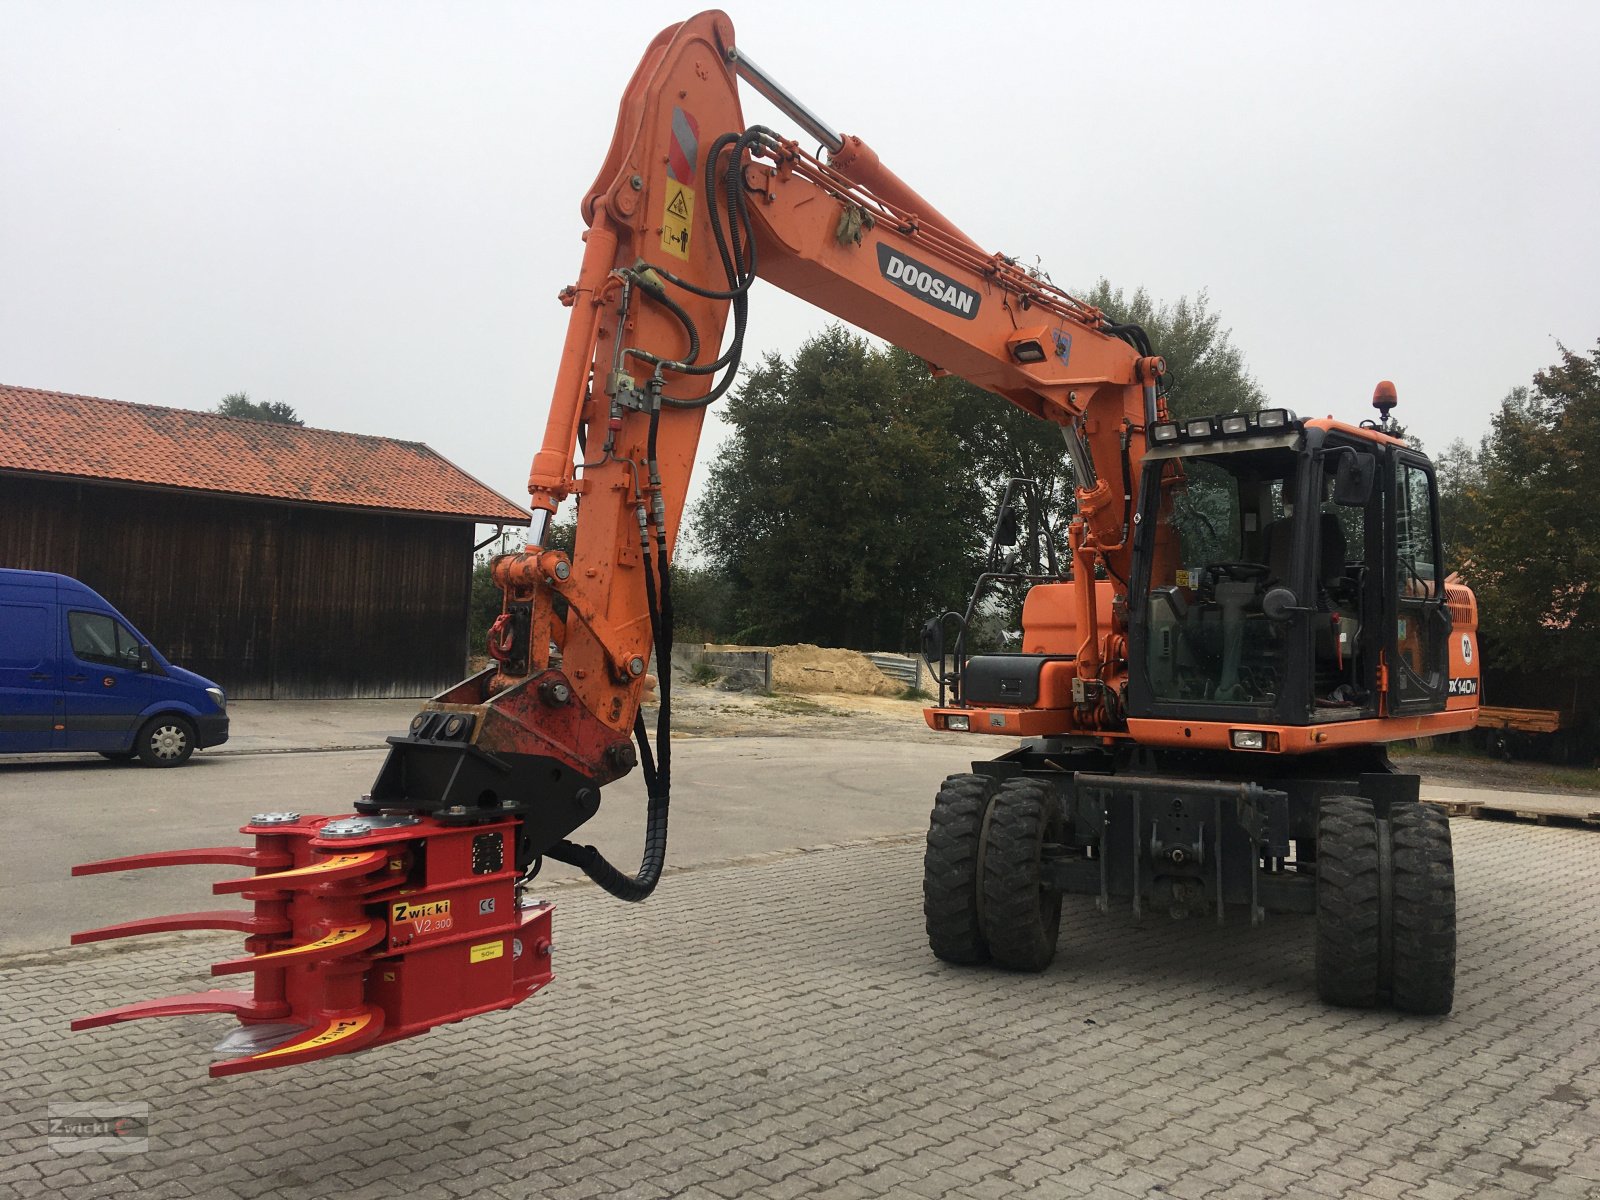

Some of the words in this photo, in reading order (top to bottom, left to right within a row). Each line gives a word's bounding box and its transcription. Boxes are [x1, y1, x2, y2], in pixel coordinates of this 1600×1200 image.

[886, 255, 974, 314] DOOSAN
[394, 901, 449, 922] Zwicki
[480, 898, 494, 911] CE
[414, 918, 452, 934] V2.300
